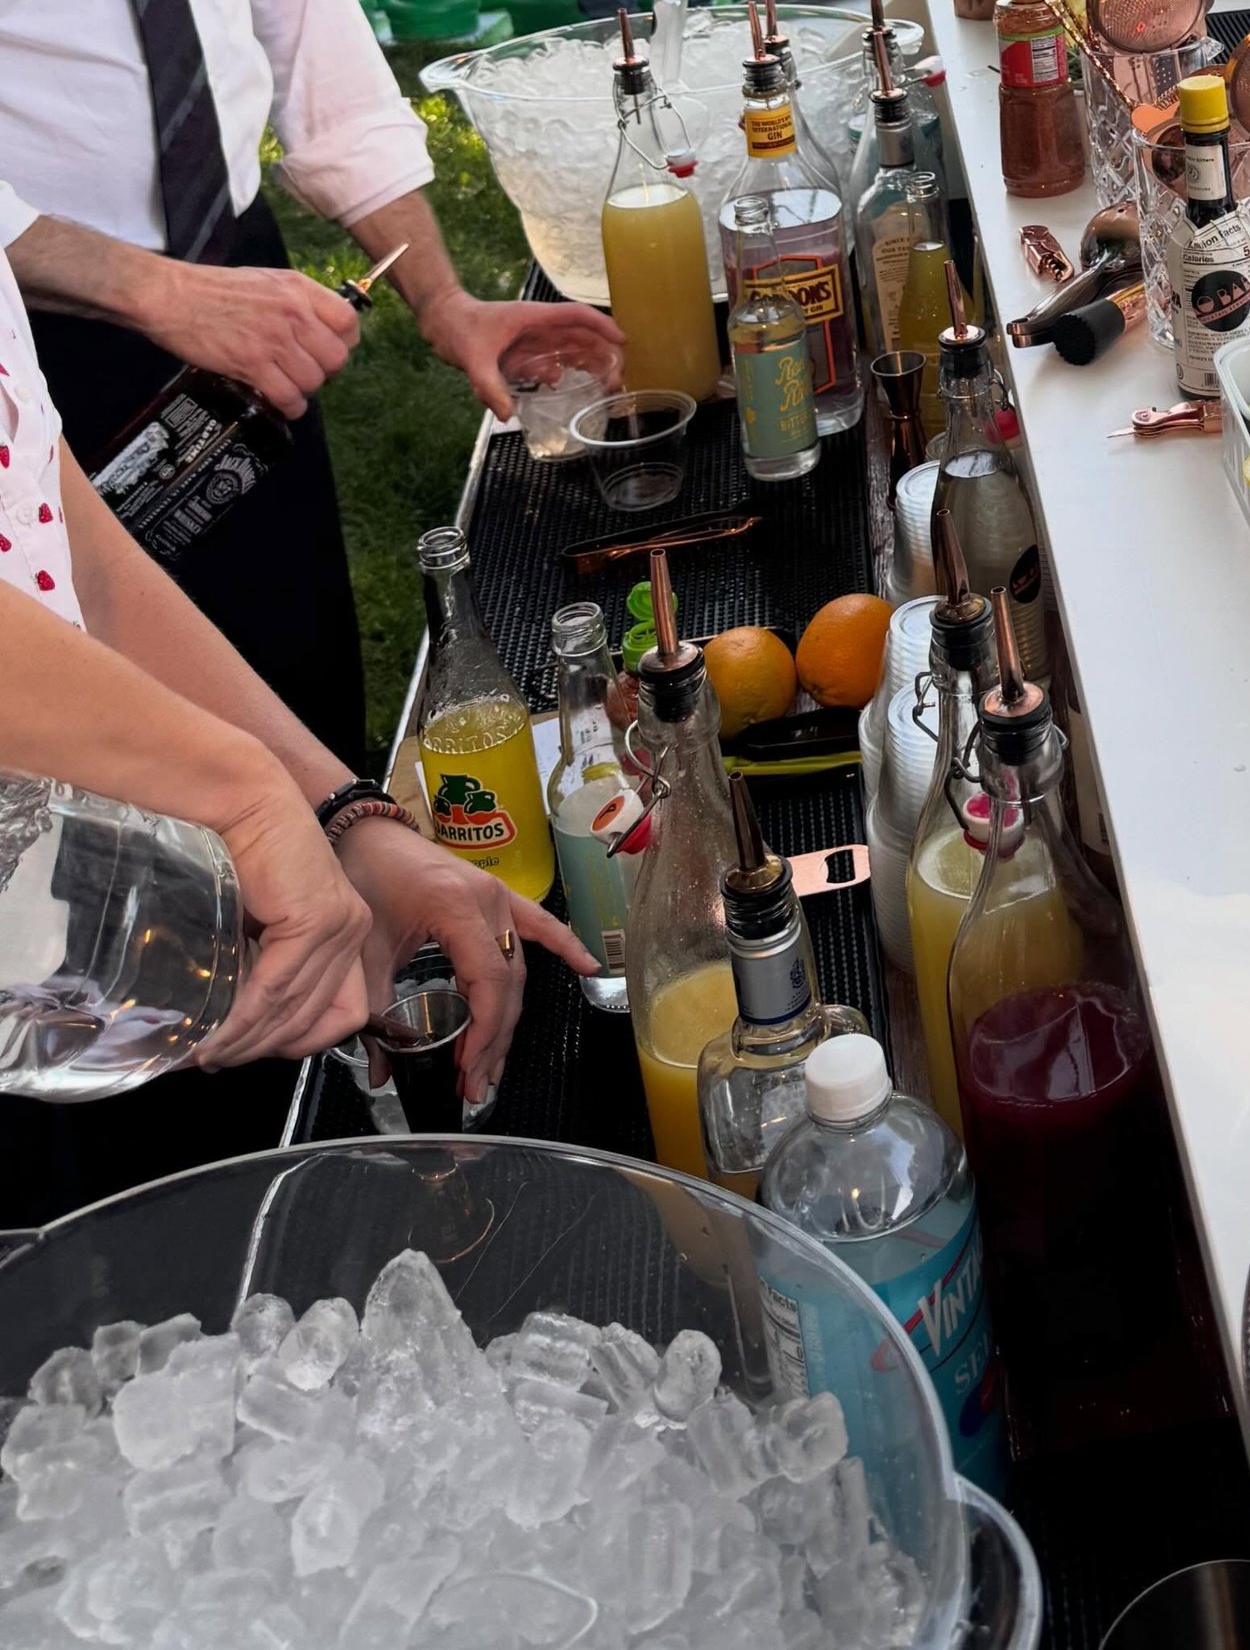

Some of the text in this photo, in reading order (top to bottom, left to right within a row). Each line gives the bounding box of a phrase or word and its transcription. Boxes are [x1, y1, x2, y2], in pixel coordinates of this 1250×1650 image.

[767, 130, 783, 140] GIN
[1183, 245, 1250, 263] Calories 5
